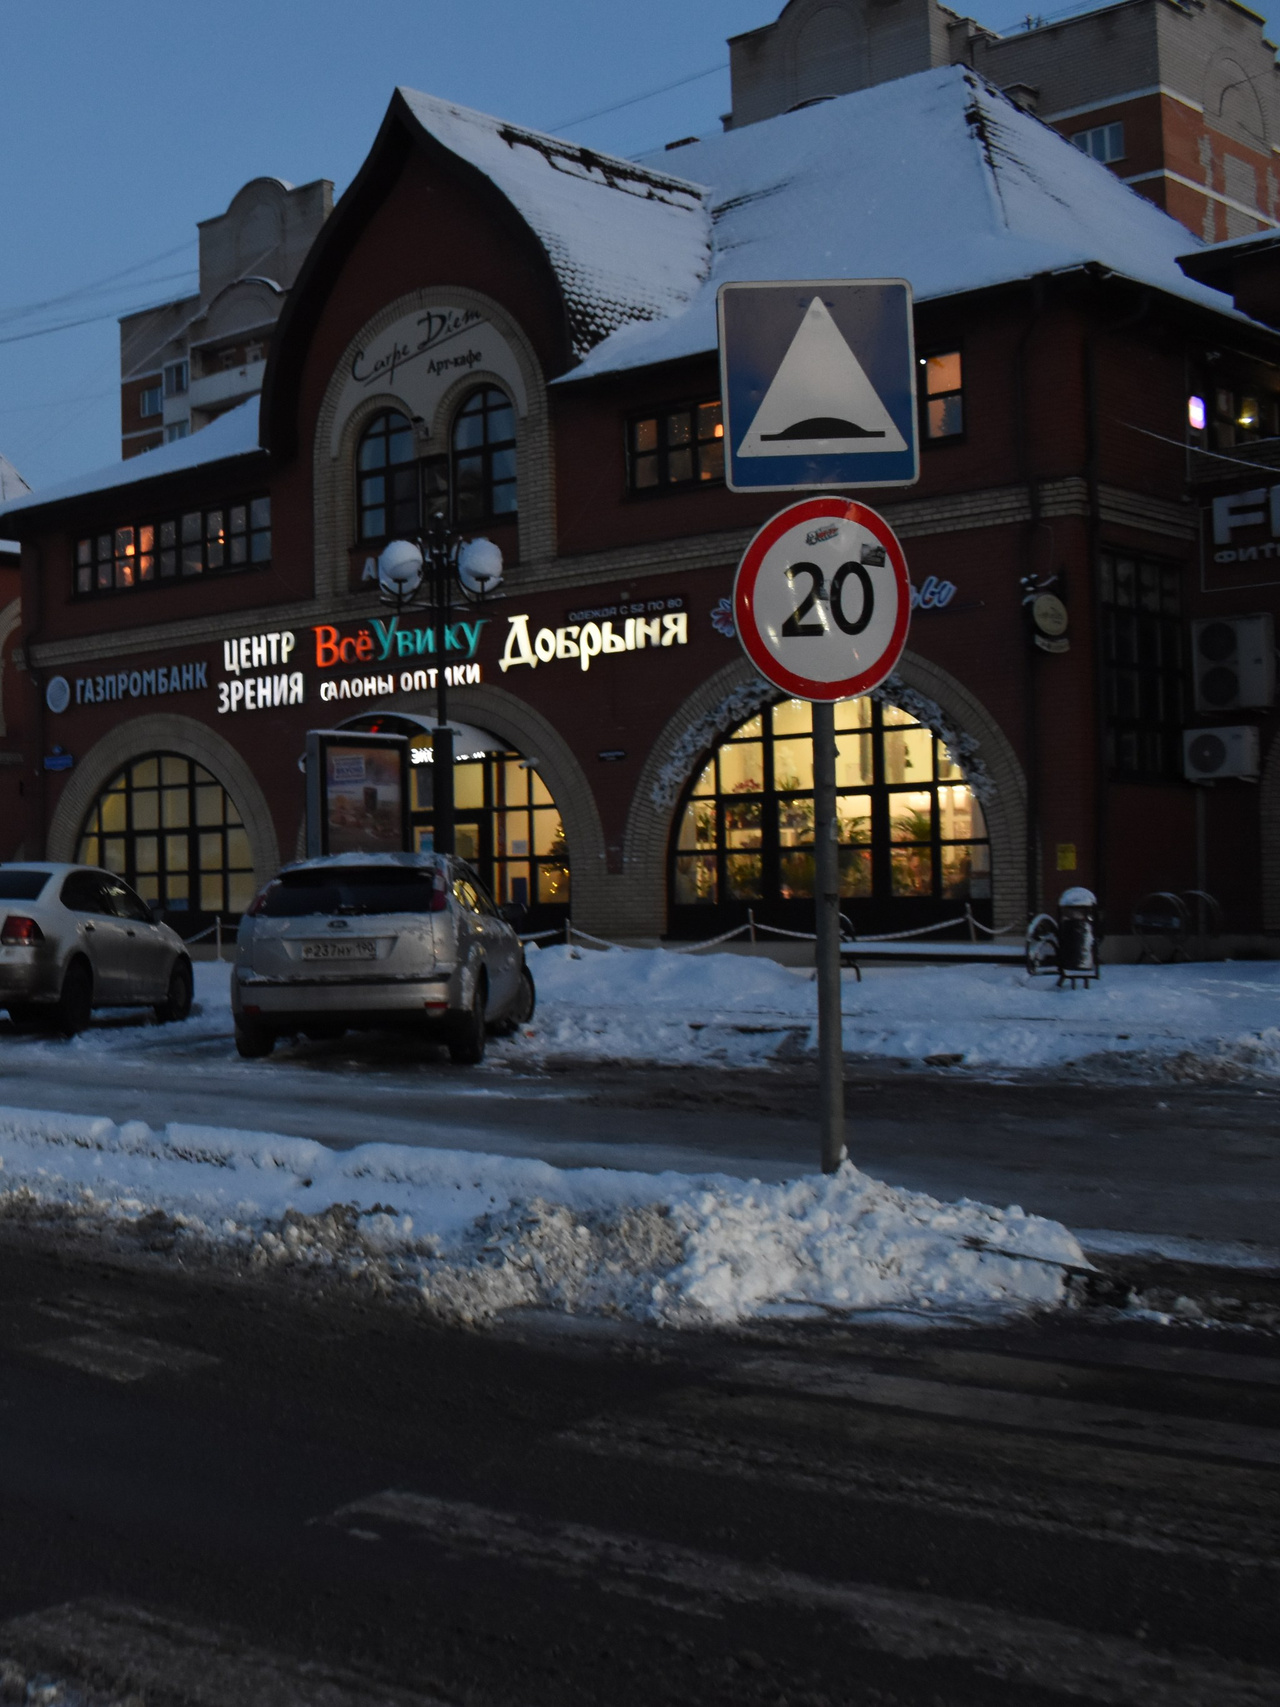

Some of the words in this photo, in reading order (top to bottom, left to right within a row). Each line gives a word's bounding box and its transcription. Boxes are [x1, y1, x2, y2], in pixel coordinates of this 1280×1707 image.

[352, 343, 410, 385] Carpe
[417, 311, 481, 350] Diem
[427, 350, 482, 376] Арт-кафе
[568, 607, 618, 622] ОДЕЖДА
[781, 561, 874, 637] 20
[224, 632, 295, 675] ЦЕНТР
[498, 612, 688, 672] Добрыня
[75, 661, 209, 704] ГАЗПРОМБАНК
[217, 672, 304, 714] ЗРЕНИЯ
[320, 673, 394, 702] САЛОНЫ
[400, 663, 480, 693] ОПТИКИ
